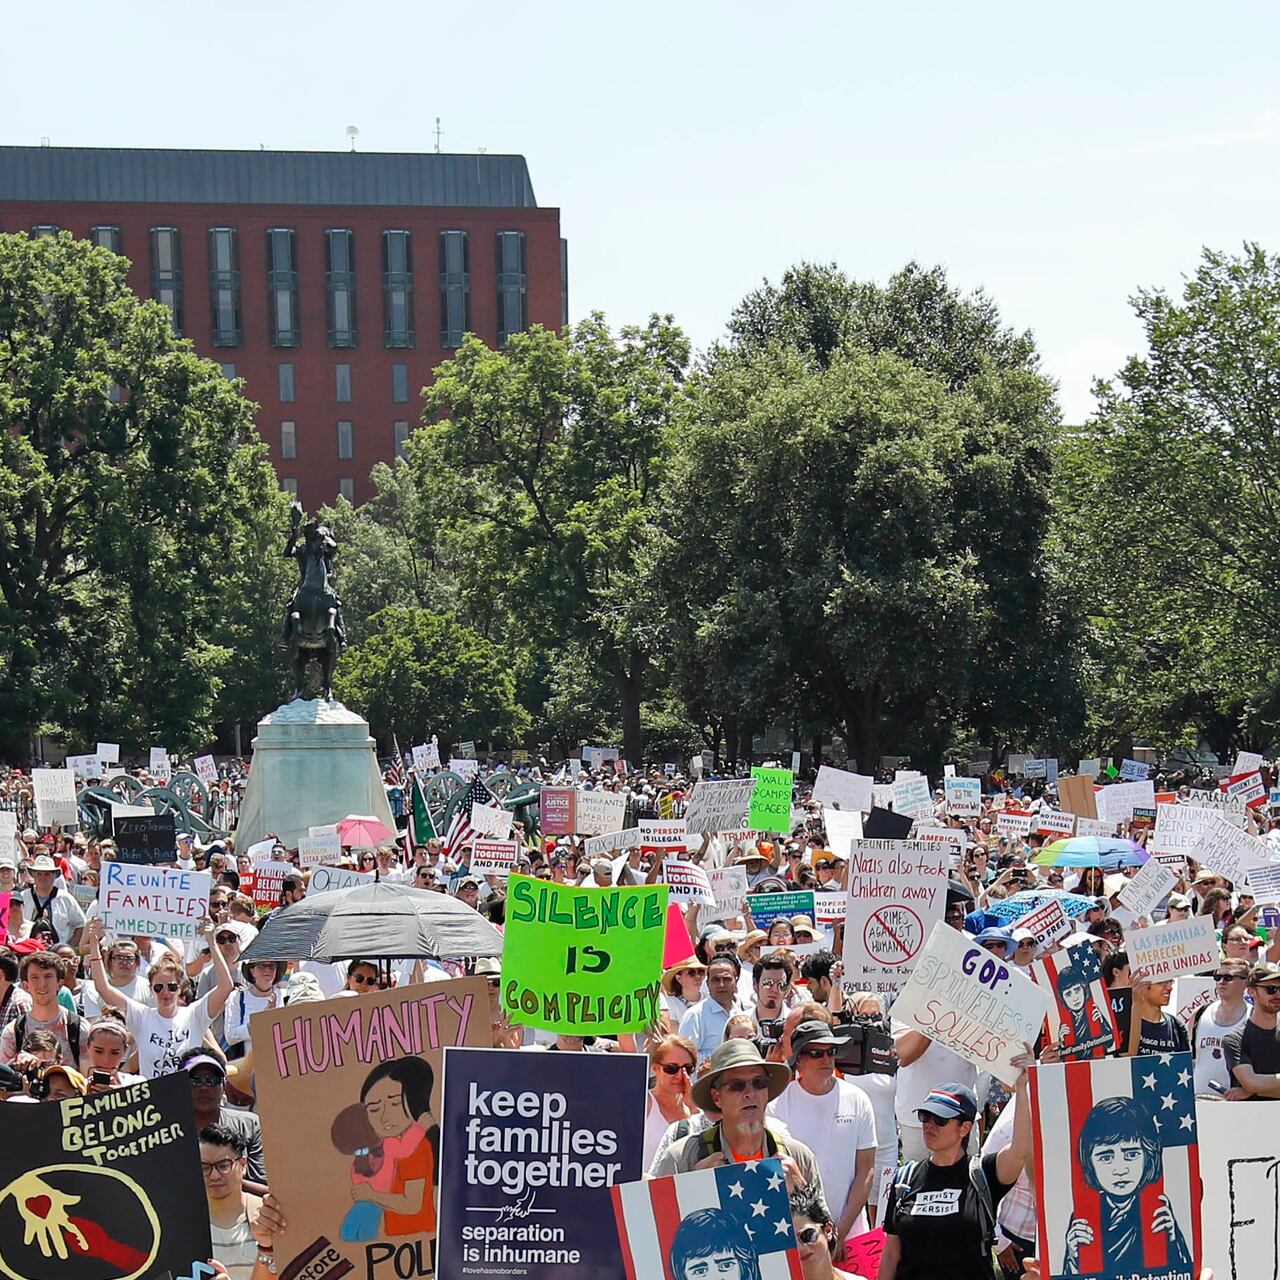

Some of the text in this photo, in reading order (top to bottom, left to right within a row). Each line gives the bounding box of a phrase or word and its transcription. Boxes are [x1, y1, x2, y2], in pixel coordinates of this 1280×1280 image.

[853, 854, 946, 876] Nazis also took
[511, 883, 664, 936] SILENCE
[851, 876, 937, 909] Children away
[869, 926, 912, 938] AGAINST
[565, 944, 612, 977] IS
[962, 949, 1013, 995] GOP:
[505, 979, 663, 1028] COMPLICITY
[913, 955, 1033, 1051] SPINELESS
[272, 990, 475, 1079] HUMANITY
[914, 1000, 1006, 1063] SOULLESS
[60, 1082, 151, 1127] FAMILIES
[469, 1081, 568, 1125] keep
[62, 1104, 162, 1151] BELONG
[82, 1123, 184, 1166] TOGETHER
[465, 1118, 618, 1156] families
[464, 1154, 622, 1195] together
[462, 1223, 565, 1245] separation
[462, 1244, 581, 1265] is inhumane
[462, 1267, 527, 1276] #lovehasnoborders
